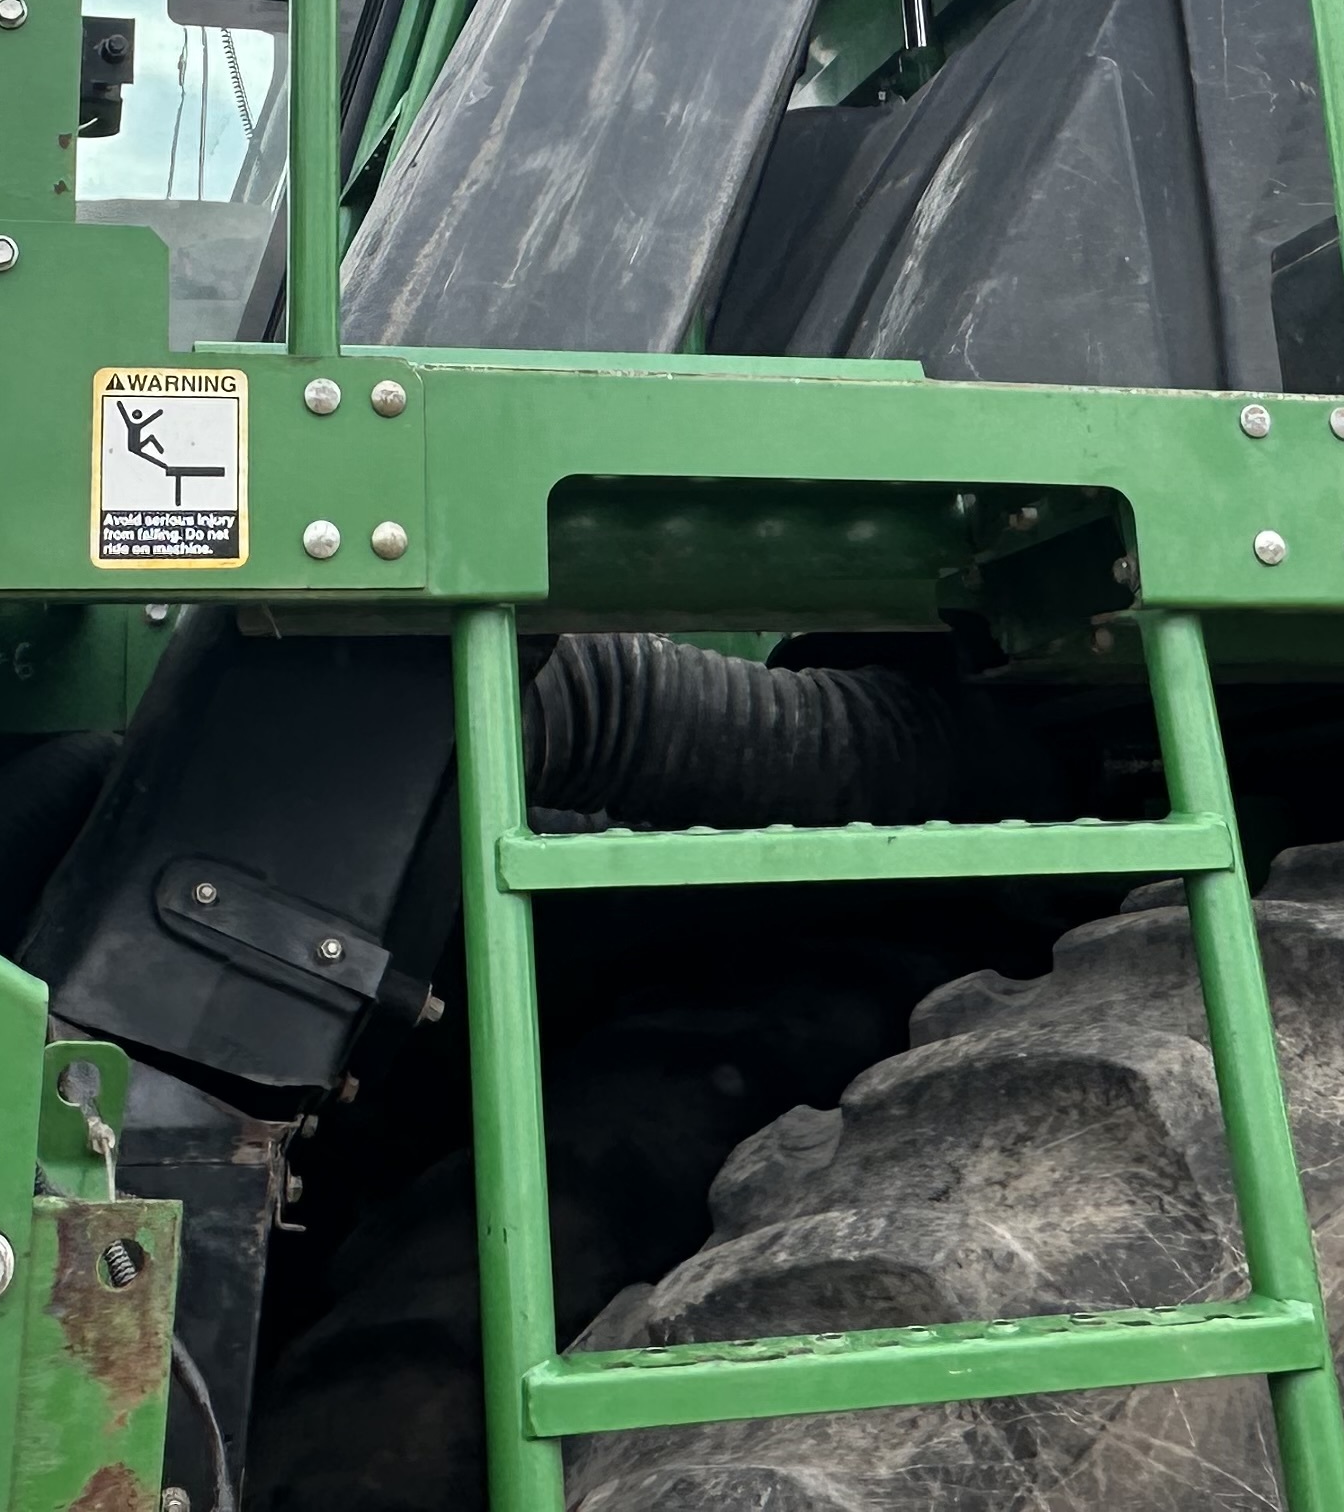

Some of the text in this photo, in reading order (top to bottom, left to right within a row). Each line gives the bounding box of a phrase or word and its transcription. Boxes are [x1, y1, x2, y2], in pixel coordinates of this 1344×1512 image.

[128, 375, 236, 392] WARNING
[103, 513, 235, 528] Avoid serious injury
[103, 528, 134, 540] from
[185, 528, 205, 540] Do
[207, 528, 230, 540] not
[103, 542, 213, 554] ride on machine.
